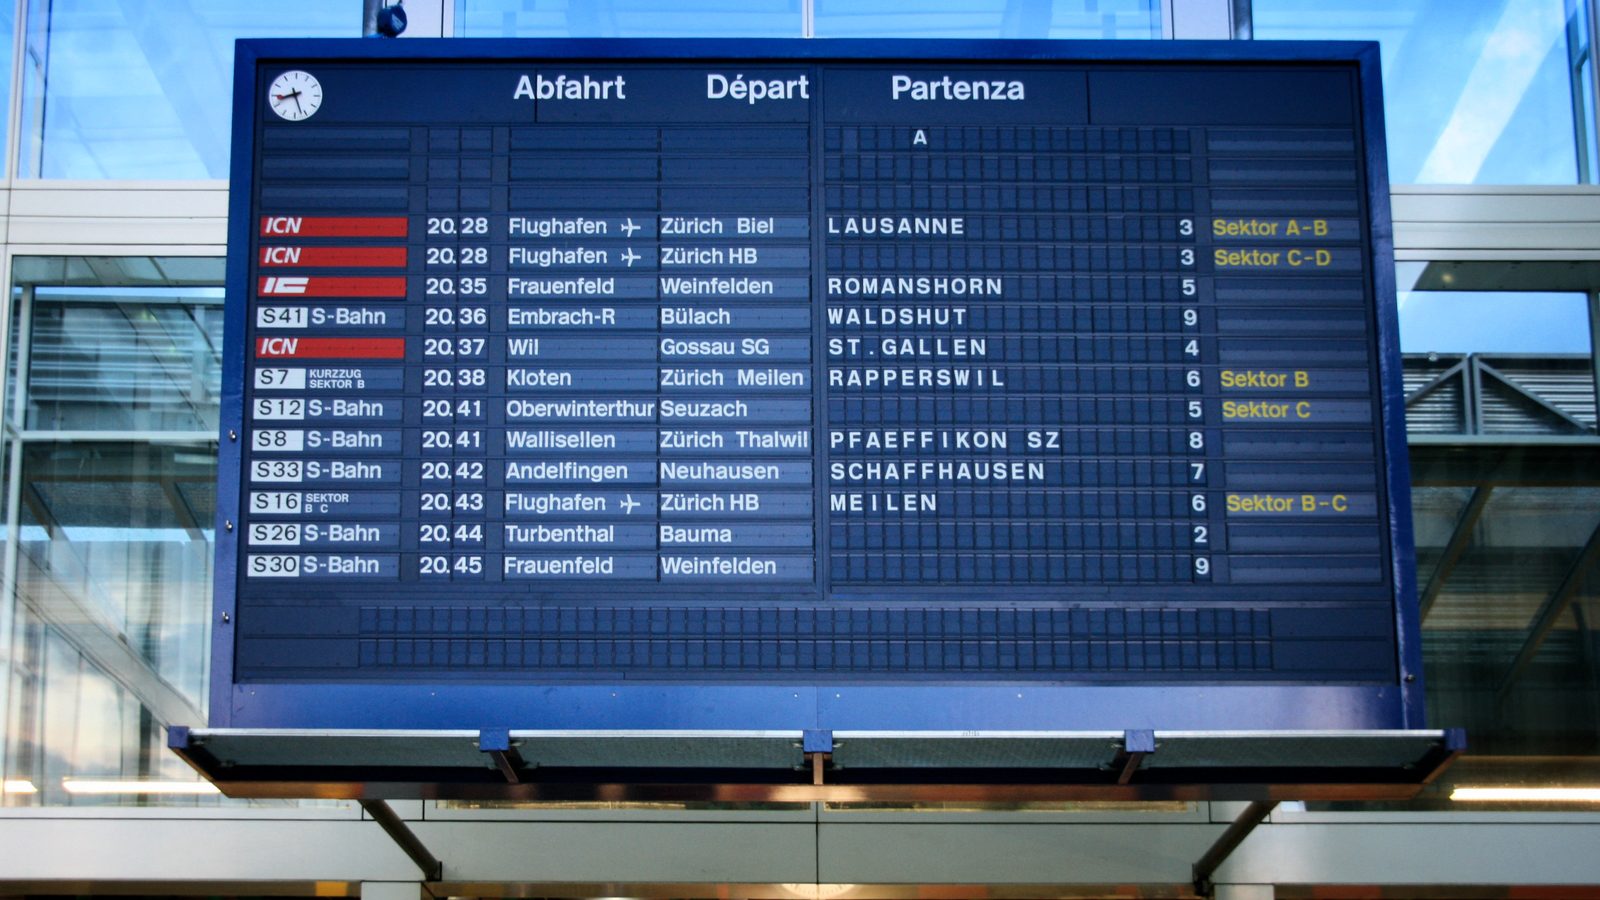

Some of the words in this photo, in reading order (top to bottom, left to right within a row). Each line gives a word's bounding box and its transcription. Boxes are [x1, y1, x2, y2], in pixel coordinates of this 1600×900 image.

[513, 74, 626, 100] Abfahrt
[707, 73, 810, 104] Départ
[891, 75, 1025, 100] Partenza
[913, 129, 928, 145] A
[265, 217, 302, 233] ICN
[428, 218, 488, 235] 20.28
[509, 217, 607, 236] Flughafen
[661, 217, 723, 234] Zürich
[737, 217, 774, 234] Biel
[828, 218, 964, 234] LAUSANNE
[1179, 219, 1193, 235] 3
[1213, 219, 1278, 236] Sektor
[264, 247, 301, 263] ICN
[426, 248, 488, 264] 20.28
[509, 247, 607, 267] Flughafen
[661, 247, 724, 264] Zürich
[729, 248, 758, 264] HB
[1180, 249, 1195, 266] 3
[1214, 249, 1280, 266] Sektor
[426, 278, 487, 295] 20.35
[508, 278, 615, 295] Frauenfeld
[661, 278, 773, 295] Weinfelden
[828, 278, 1002, 295] ROMANSHORN
[1182, 279, 1196, 296] 5
[262, 308, 302, 323] S41
[311, 308, 386, 325] S-Bahn
[425, 308, 486, 325] 20.36
[508, 308, 615, 325] Embrach-R
[661, 308, 731, 325] Bülach
[827, 308, 967, 325] WALDSHUT
[1183, 309, 1198, 326] 9
[261, 338, 298, 355] ICN
[424, 338, 485, 356] 20.37
[508, 338, 539, 356] Wil
[660, 338, 735, 356] Gossau
[740, 338, 770, 356] SG
[829, 338, 986, 355] ST.GALLEN
[1184, 339, 1199, 356] 4
[260, 369, 289, 384] S7
[309, 369, 362, 379] KURZZUG
[424, 369, 485, 386] 20.38
[506, 369, 572, 386] Kloten
[660, 369, 724, 386] Zürich
[737, 369, 804, 386] Meilen
[829, 370, 1005, 387] RAPPERSWIL
[1186, 370, 1201, 387] 6
[1221, 370, 1287, 387] Sektor
[1295, 370, 1309, 387] B
[309, 379, 353, 389] SEKTOR
[357, 379, 365, 389] B
[259, 400, 301, 415] S12
[308, 400, 383, 417] S-Bahn
[423, 400, 481, 417] 20.41
[506, 400, 654, 417] Oberwinterthur
[660, 400, 748, 417] Seuzach
[1188, 401, 1202, 418] 5
[1222, 400, 1288, 418] Sektor
[1296, 401, 1311, 418] C
[258, 431, 287, 447] S8
[307, 431, 382, 448] S-Bahn
[422, 431, 480, 448] 20.41
[506, 431, 616, 448] Wallisellen
[660, 431, 724, 448] Zürich
[736, 431, 808, 448] Thalwil
[831, 431, 1007, 448] PFAEFFIKON
[1027, 431, 1060, 448] SZ
[1189, 431, 1204, 449] 8
[257, 461, 299, 478] S33
[306, 462, 381, 479] S-Bahn
[421, 462, 483, 480] 20.42
[506, 462, 628, 482] Andelfingen
[660, 462, 779, 479] Neuhausen
[831, 463, 1044, 480] SCHAFFHAUSEN
[1191, 463, 1205, 480] 7
[256, 494, 298, 509] S16
[306, 494, 349, 503] SEKTOR
[421, 493, 483, 511] 20.43
[505, 493, 607, 514] Flughafen
[660, 493, 724, 511] Zürich
[730, 494, 760, 511] HB
[831, 494, 937, 511] MEILEN
[1191, 494, 1206, 512] 6
[1226, 494, 1293, 512] Sektor
[305, 504, 313, 514] B
[320, 504, 329, 514] C
[254, 524, 297, 540] S26
[304, 524, 380, 542] S-Bahn
[420, 524, 483, 542] 20.44
[505, 525, 614, 542] Turbenthal
[660, 525, 732, 542] Bauma
[1193, 526, 1207, 543] 2
[253, 556, 296, 572] S30
[303, 556, 379, 573] S-Bahn
[419, 556, 482, 574] 20.45
[504, 557, 613, 574] Frauenfeld
[661, 557, 777, 574] Weinfelden
[1195, 557, 1209, 575] 9
